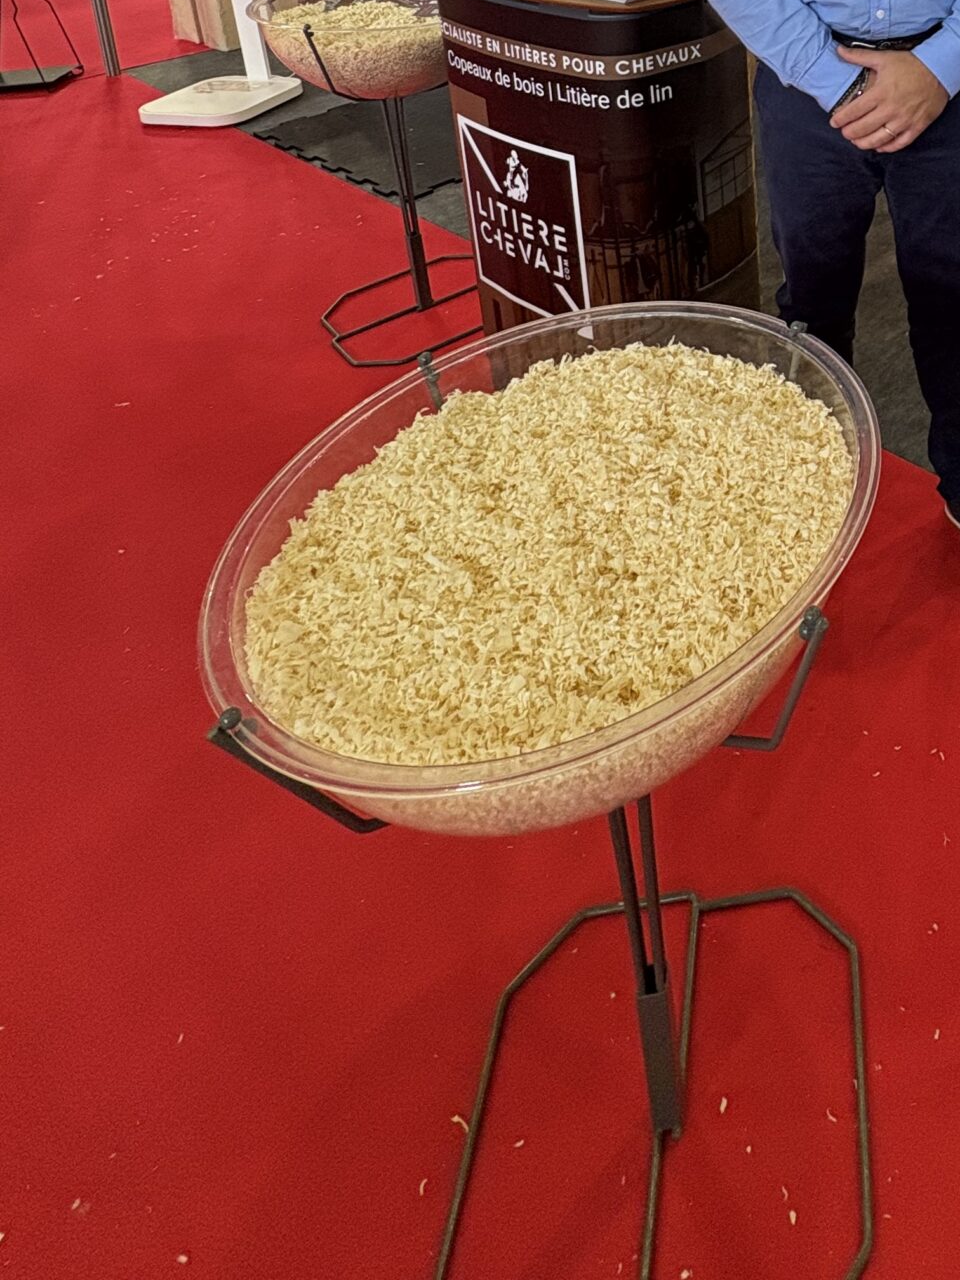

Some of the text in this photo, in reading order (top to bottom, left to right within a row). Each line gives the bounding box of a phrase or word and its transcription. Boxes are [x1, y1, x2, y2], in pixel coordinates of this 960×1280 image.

[447, 49, 674, 110] Copeaux de bois Litière de lin
[486, 38, 500, 54] EN
[504, 42, 557, 68] LITIÈRES
[562, 55, 606, 76] POUR
[615, 43, 702, 76] CHEVAUX
[475, 190, 568, 253] LITIERE
[480, 220, 564, 279] CHEVAL
